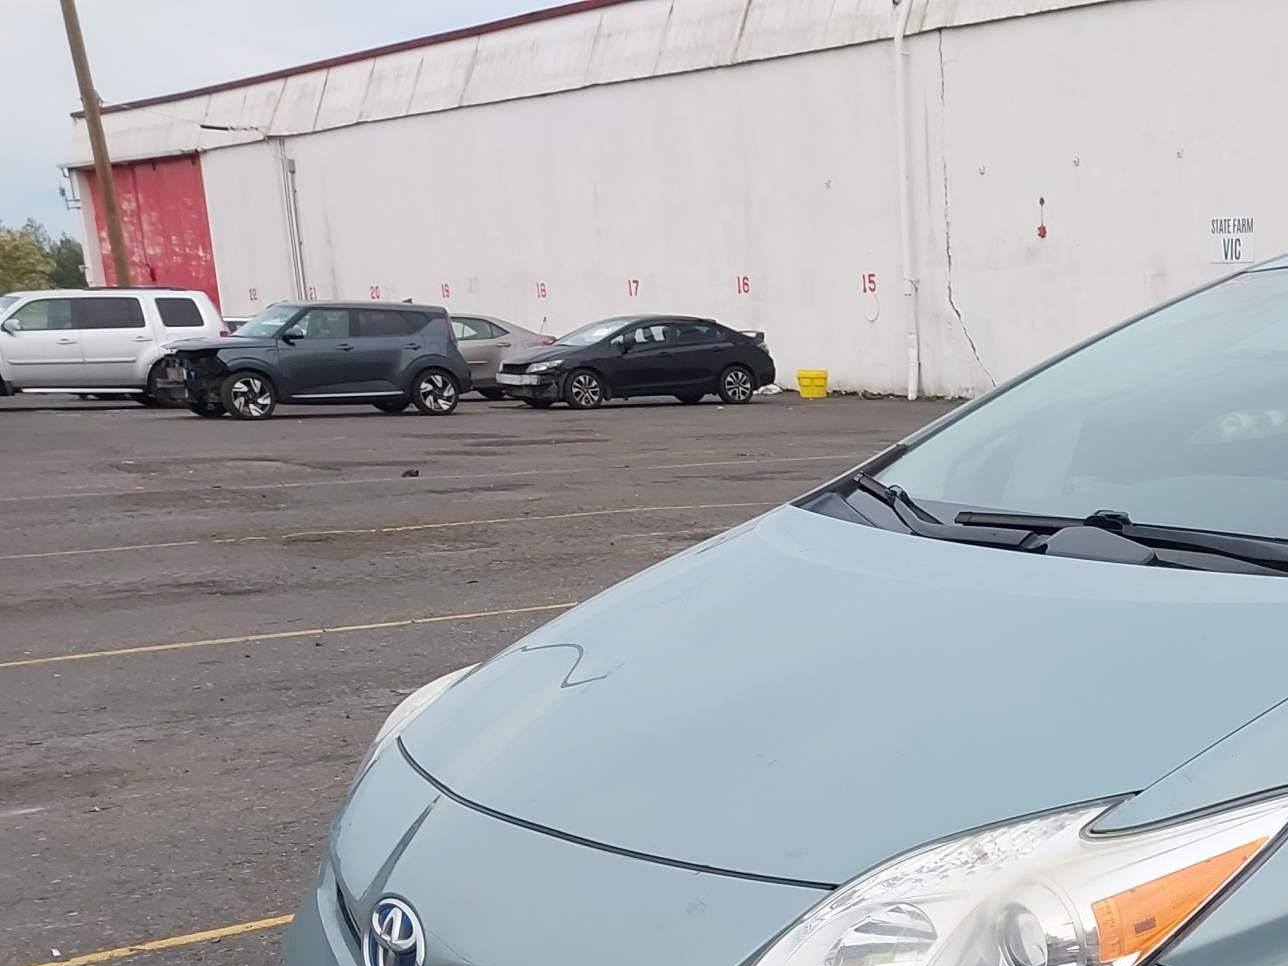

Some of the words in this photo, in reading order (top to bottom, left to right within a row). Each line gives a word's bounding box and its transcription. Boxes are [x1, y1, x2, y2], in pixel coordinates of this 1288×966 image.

[1211, 218, 1231, 234] STATE
[1233, 217, 1254, 234] FARM
[1223, 238, 1241, 261] VIC
[440, 283, 450, 299] 19
[536, 282, 547, 298] 18
[627, 279, 640, 296] 17
[737, 276, 750, 294] 16
[862, 273, 876, 294] 15
[308, 286, 318, 301] 21
[370, 285, 381, 300] 20
